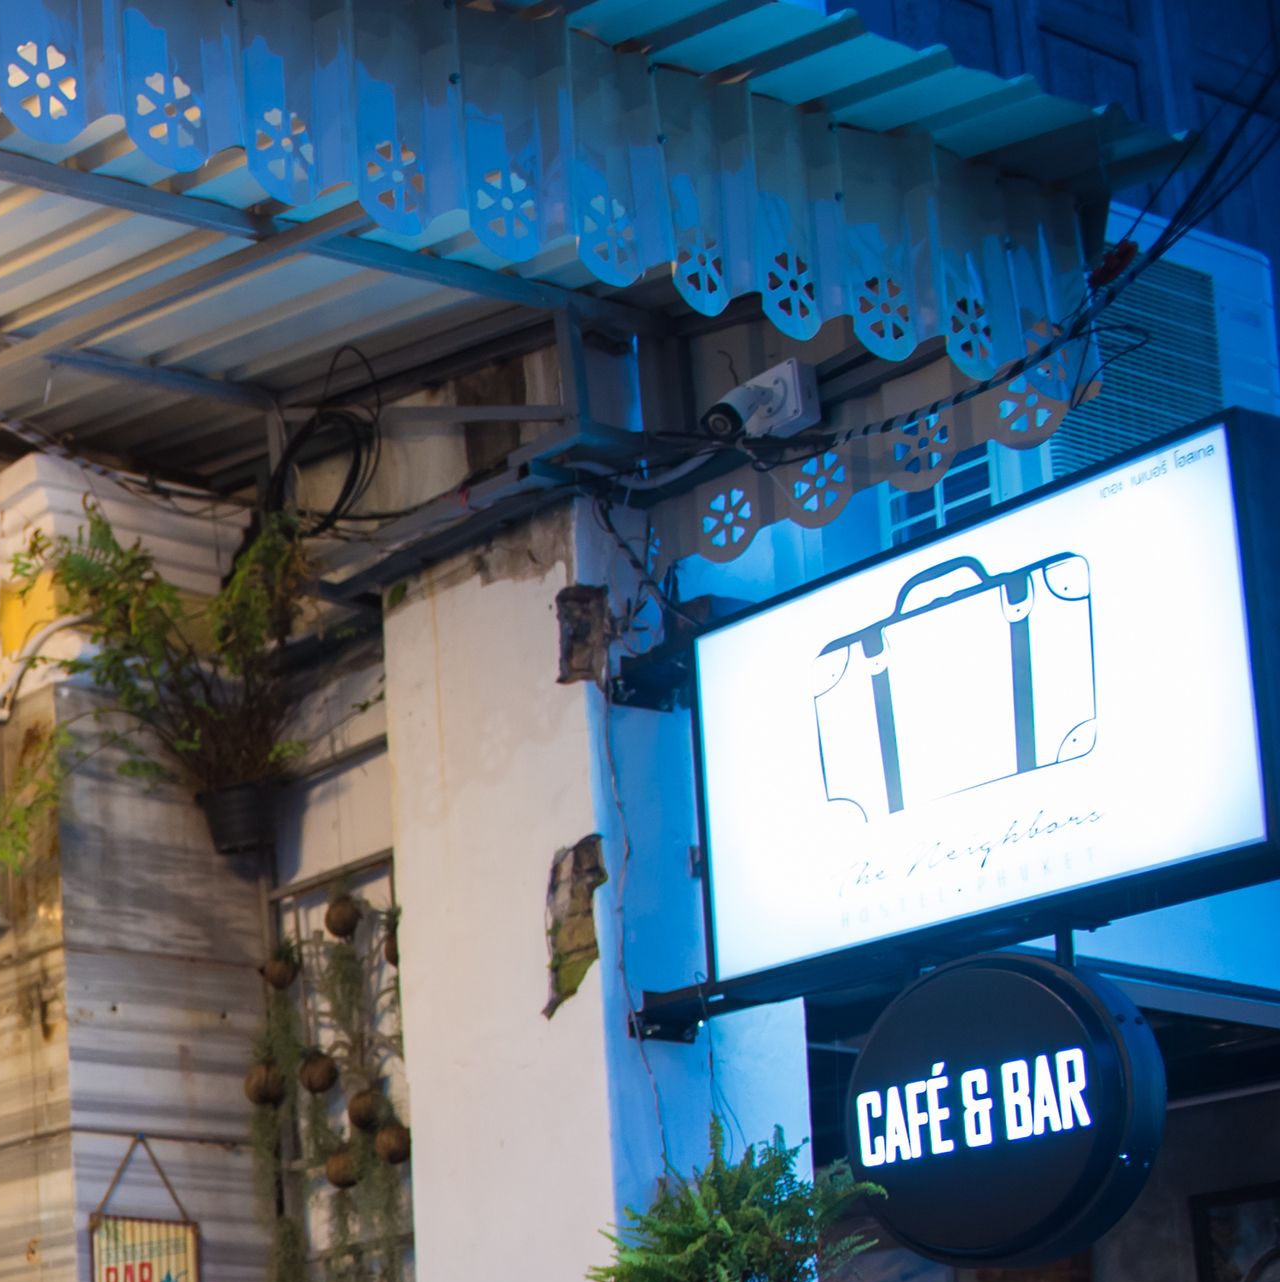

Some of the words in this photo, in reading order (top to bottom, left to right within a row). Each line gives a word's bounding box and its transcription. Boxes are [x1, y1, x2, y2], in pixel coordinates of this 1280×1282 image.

[906, 808, 1107, 878] Neighbors
[856, 1061, 954, 1168] CAFÉ
[960, 1068, 993, 1148] &
[1000, 1048, 1091, 1141] BAR
